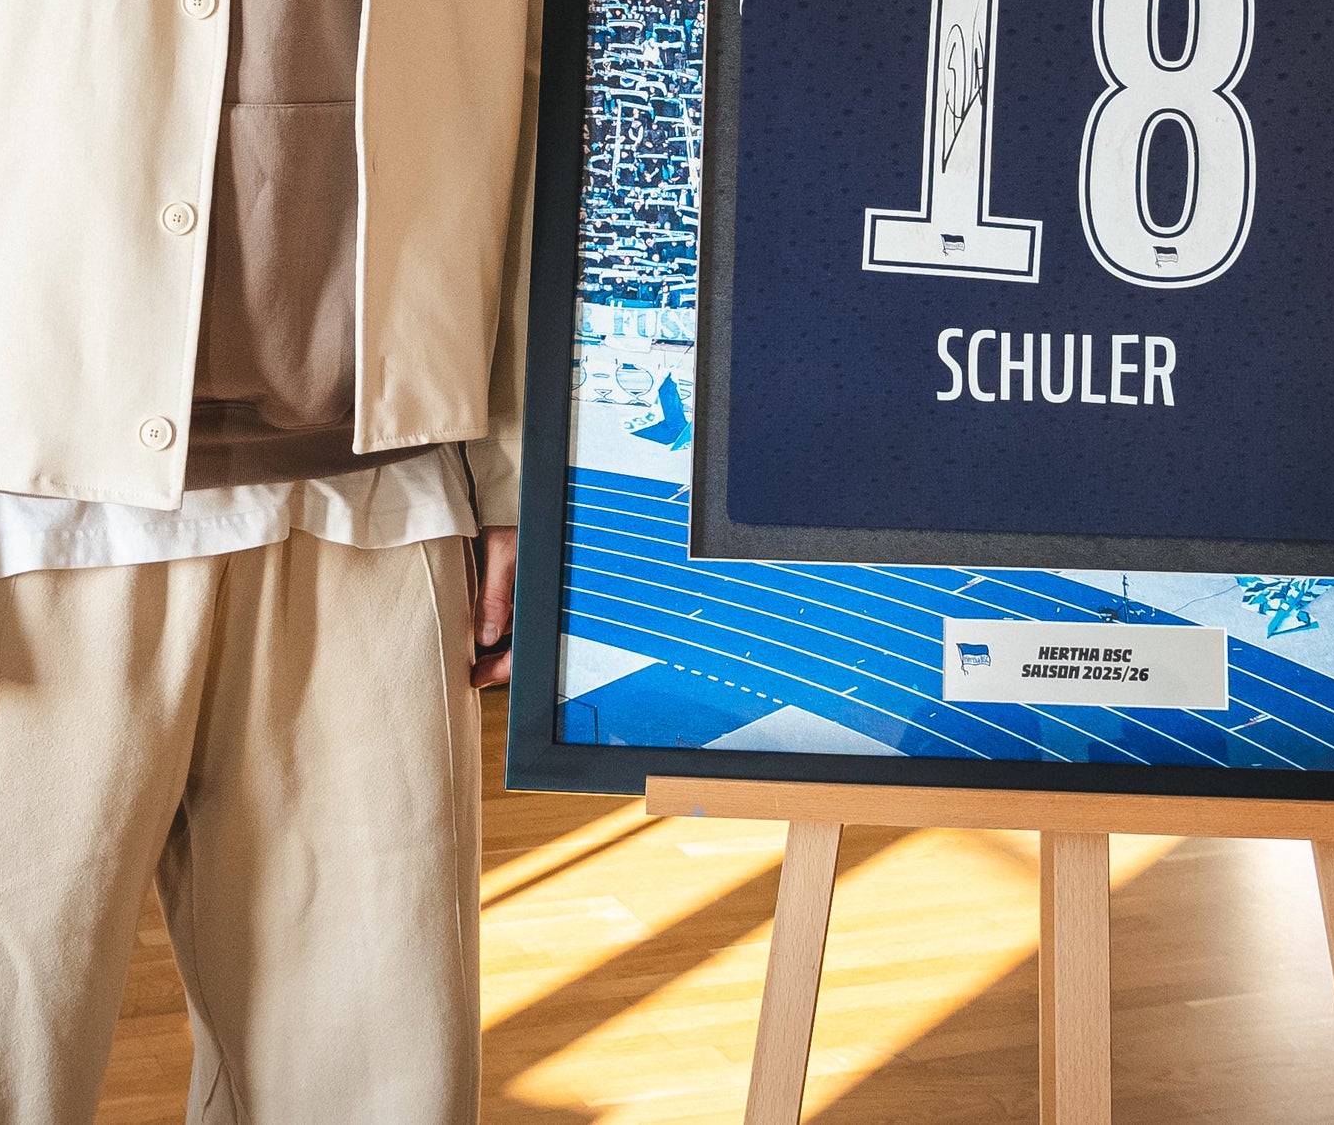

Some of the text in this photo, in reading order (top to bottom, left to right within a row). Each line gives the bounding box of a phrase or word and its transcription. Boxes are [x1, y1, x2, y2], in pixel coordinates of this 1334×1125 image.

[936, 327, 1176, 406] SCHULER
[1038, 646, 1132, 663] HERTHA BSC
[1021, 664, 1149, 682] SAISON 2025/26
